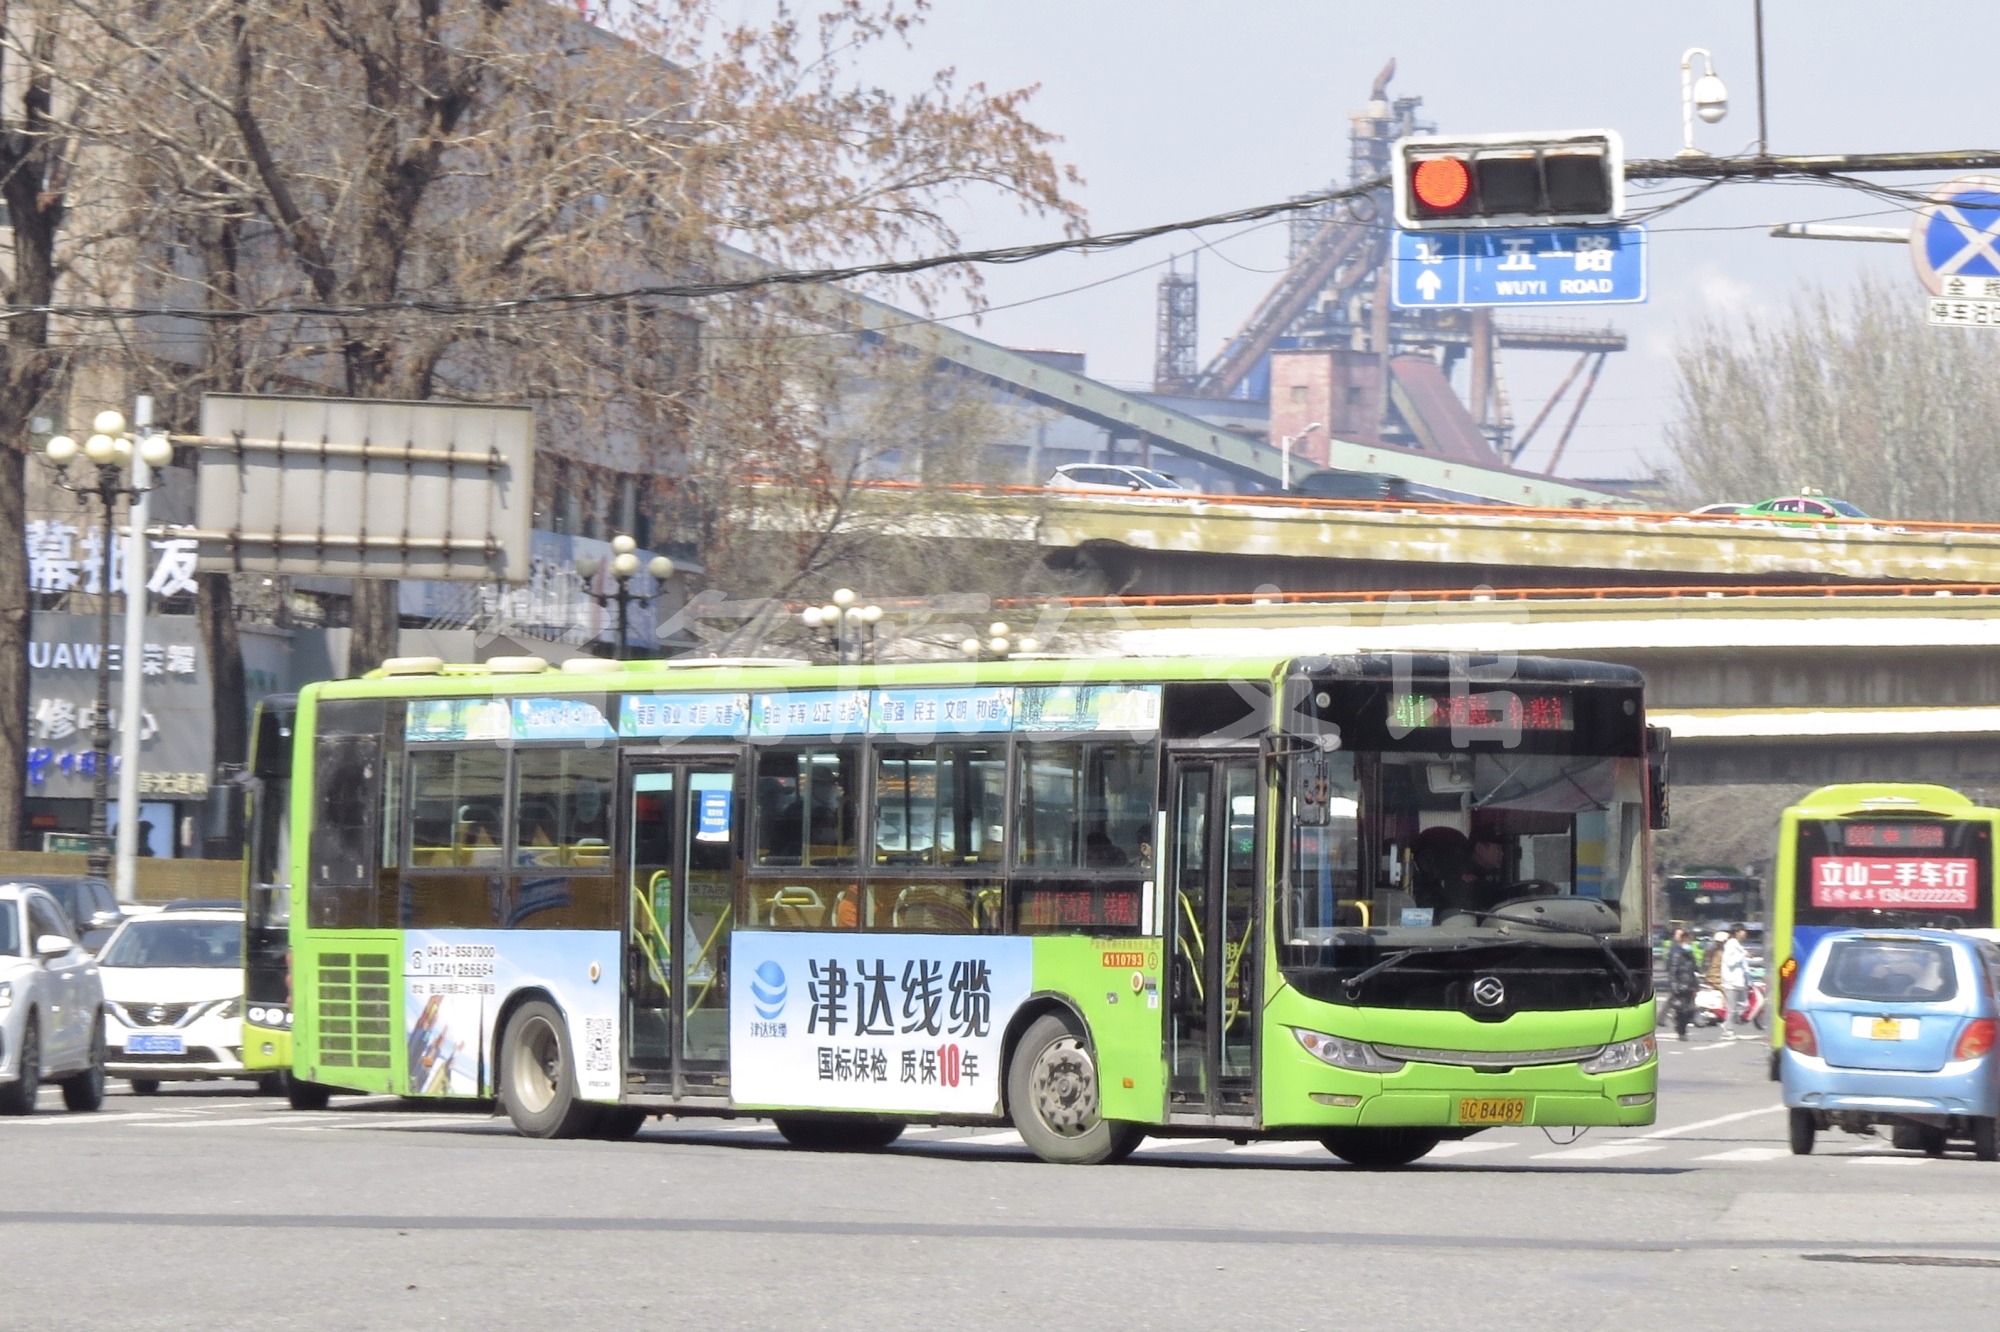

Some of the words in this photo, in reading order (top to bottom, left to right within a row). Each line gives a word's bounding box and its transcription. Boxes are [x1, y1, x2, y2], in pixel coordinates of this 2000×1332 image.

[1497, 235, 1614, 272] 五一路
[1495, 279, 1547, 295] WUYI
[1559, 277, 1614, 294] ROAD
[28, 698, 160, 740] 修中心
[763, 704, 781, 726] 自由
[788, 702, 807, 724] 平等
[813, 702, 832, 723] 公正
[883, 701, 905, 722] 富强
[914, 700, 937, 721] 民主
[945, 699, 968, 720] 文明
[976, 699, 999, 720] 和谐
[1820, 861, 1968, 888] 立山二手车行
[1103, 953, 1143, 967] 4110793
[807, 958, 992, 1039] 津达线缆
[750, 1021, 788, 1039] 津达线缆
[817, 1046, 888, 1083] 国标保检
[900, 1043, 980, 1088] 质保10年
